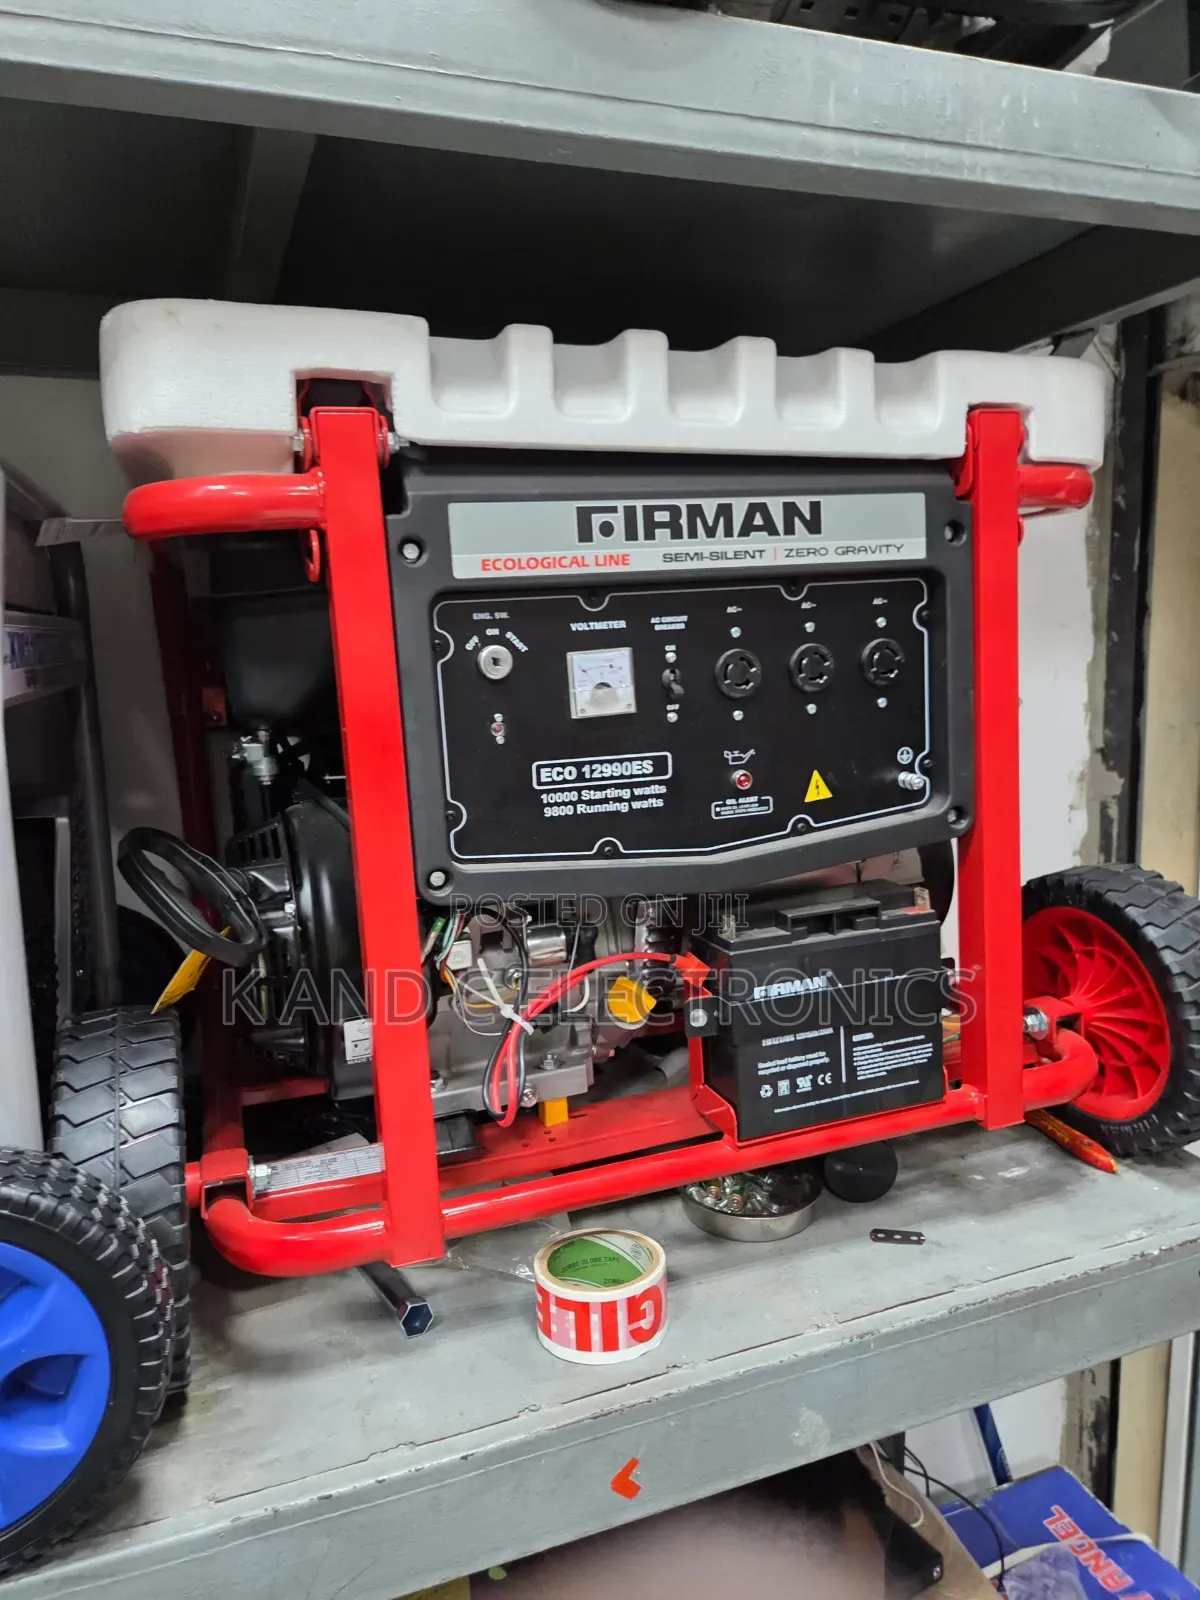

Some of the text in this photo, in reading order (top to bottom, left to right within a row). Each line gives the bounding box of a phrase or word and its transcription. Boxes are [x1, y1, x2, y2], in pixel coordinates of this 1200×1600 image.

[575, 500, 822, 544] FIRMAN
[480, 553, 631, 572] ECOLOGICAL LINE
[662, 543, 905, 563] SEMI-SILENT ZERO GRAVITY
[570, 620, 627, 632] VOLTMETER
[650, 615, 688, 624] AC CIRCUIT
[654, 622, 686, 631] BREAKER
[485, 628, 500, 636] ON
[465, 635, 480, 651] OFF
[505, 631, 529, 653] START
[539, 759, 654, 783] ECO 12990ES
[540, 784, 667, 804] 10000 Starting watts
[543, 797, 665, 818] 9800 Running watts
[581, 1256, 603, 1266] GLOBE
[604, 1256, 621, 1264] TAPE
